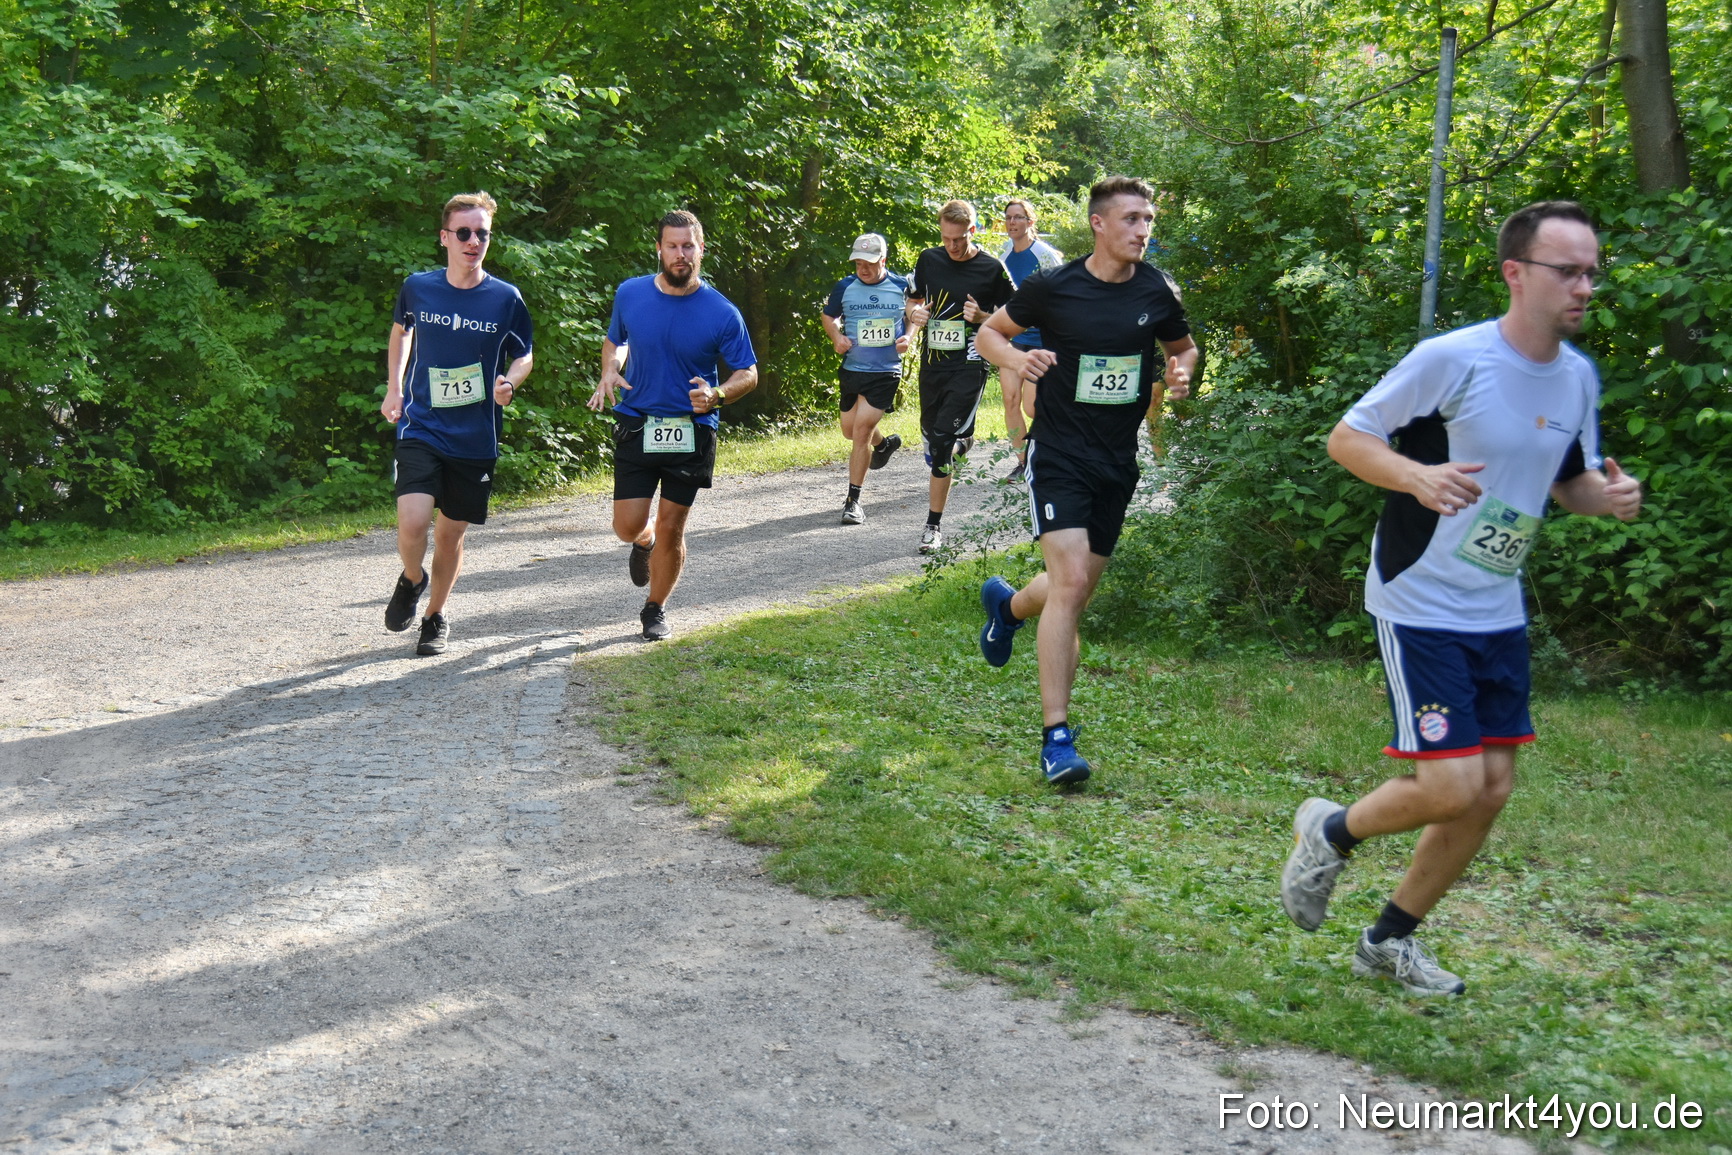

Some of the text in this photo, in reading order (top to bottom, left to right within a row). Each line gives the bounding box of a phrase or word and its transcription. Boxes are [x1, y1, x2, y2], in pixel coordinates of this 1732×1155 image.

[420, 311, 498, 333] EURO POLES
[862, 328, 890, 339] 2118
[932, 331, 960, 342] 1742
[440, 380, 472, 397] 713
[1091, 373, 1128, 391] 432
[654, 428, 683, 442] 870
